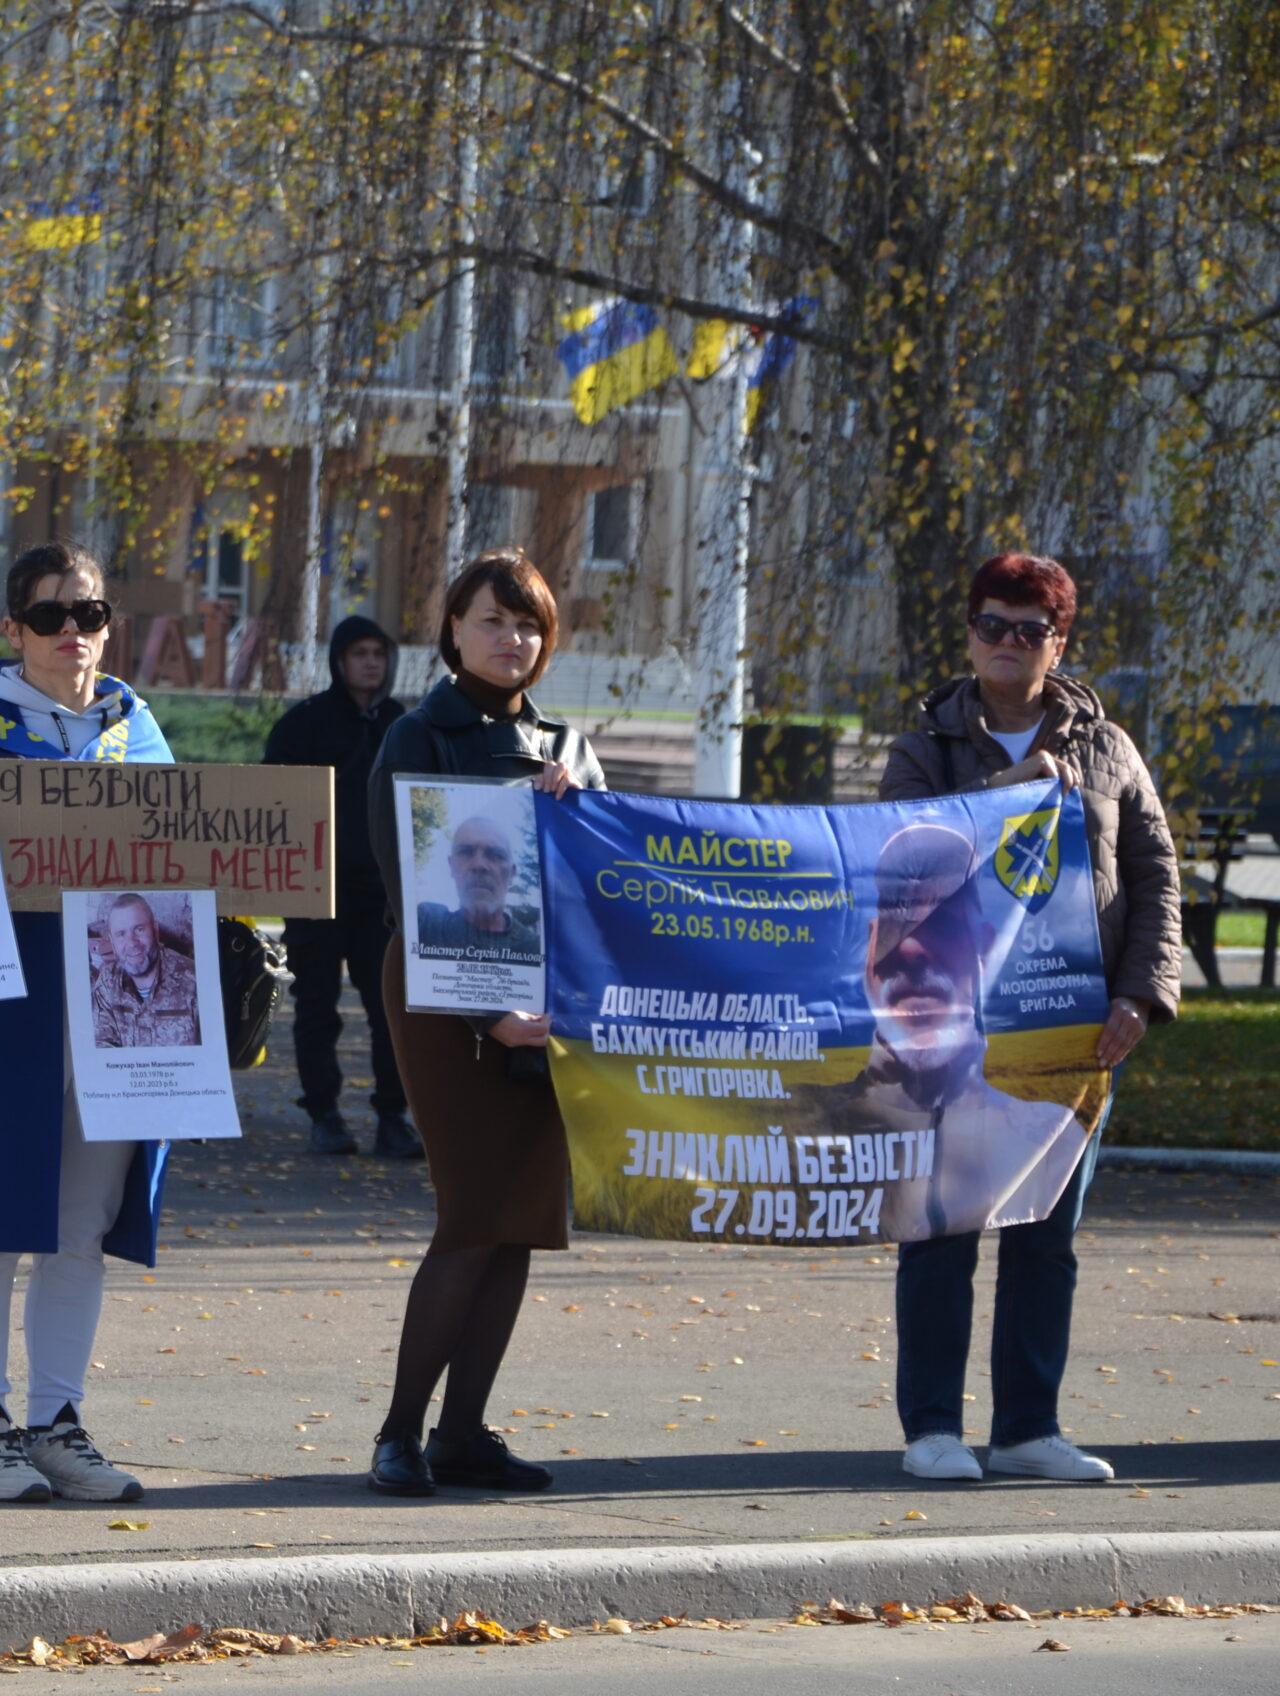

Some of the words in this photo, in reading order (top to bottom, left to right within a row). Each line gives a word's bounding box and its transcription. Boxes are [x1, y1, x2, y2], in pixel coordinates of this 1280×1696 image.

[0, 766, 23, 805] Я
[40, 767, 203, 810] БЕЗВІСТИ
[646, 831, 793, 867] МАЙСТЕР
[596, 869, 706, 908] Сергій
[713, 881, 854, 911] Павлович
[651, 913, 815, 947] 23.05.1968р.н.
[1021, 921, 1055, 954] 56
[1016, 956, 1067, 975] ОКРЕМА
[1000, 973, 1091, 996] МОТОПІХОТНА
[600, 985, 716, 1022] ДОНЕЦЬКА
[721, 993, 814, 1025] ОБЛАСТЬ,
[1020, 994, 1076, 1014] БРИГАДА
[591, 1023, 746, 1061] БАХМУТСЬКИЙ
[750, 1026, 825, 1062] РАЙОН,
[637, 1065, 791, 1100] С.ГРИГОРІВКА.
[623, 1125, 790, 1184] ЗНИКЛИЙ
[795, 1129, 935, 1184] БЕЗВІСТИ
[690, 1187, 884, 1238] 27.09.2024
